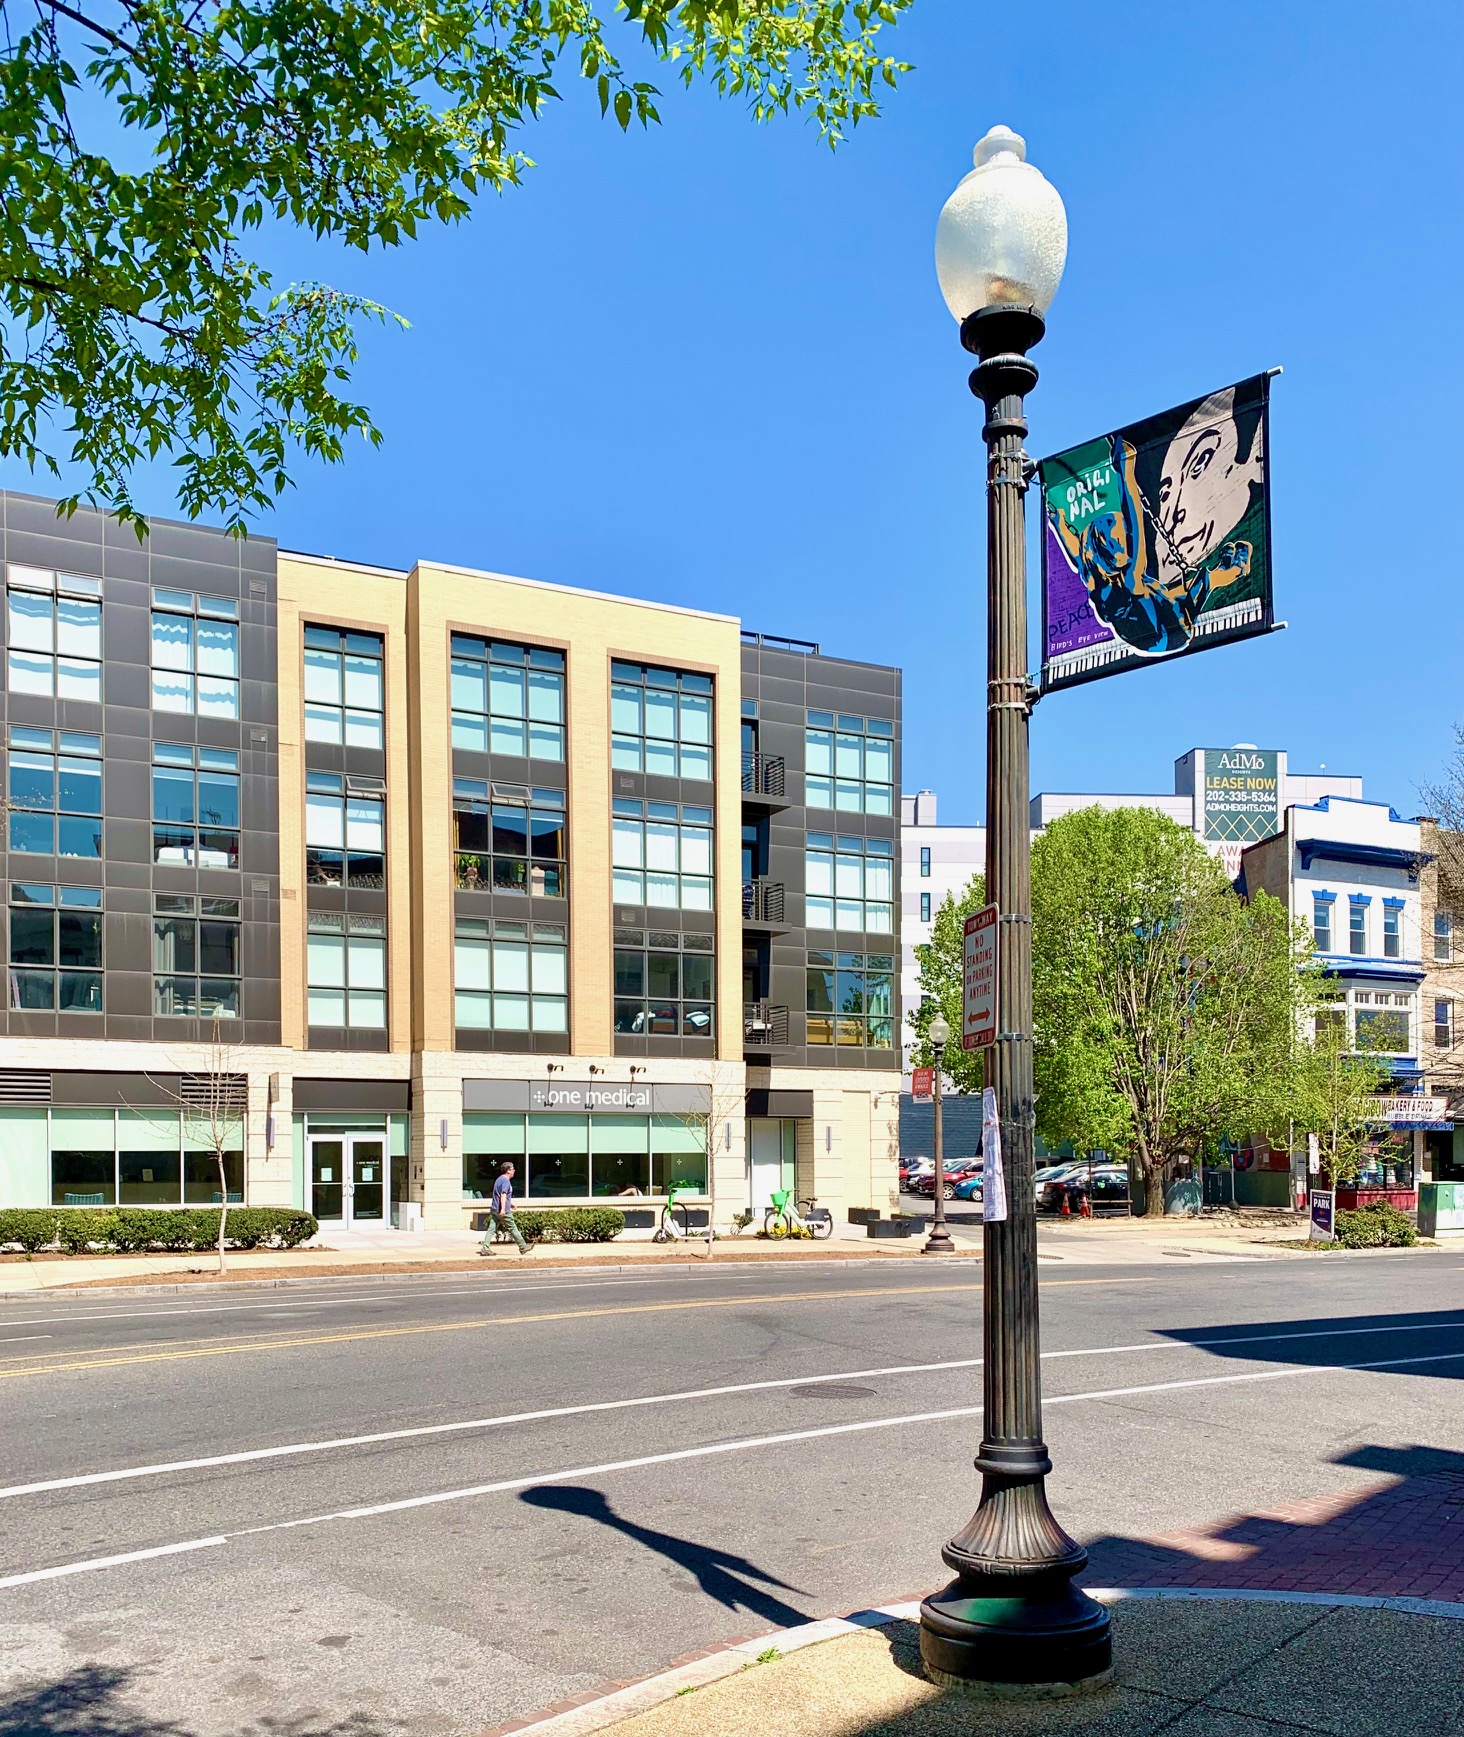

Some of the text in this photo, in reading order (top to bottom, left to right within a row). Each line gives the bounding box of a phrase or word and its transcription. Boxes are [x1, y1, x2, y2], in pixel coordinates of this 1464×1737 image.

[1070, 489, 1106, 523] NAL
[1050, 640, 1073, 652] BIRD'S
[1077, 635, 1091, 644] EYE
[1206, 776, 1276, 790] LEASE NOW
[1205, 790, 1276, 803] 202-335-5364
[1205, 803, 1276, 813] ADMOHEIGHTS.COM
[974, 934, 984, 949] NO
[966, 946, 992, 969] STANDING
[973, 963, 993, 983] PARKING
[969, 981, 991, 1001] ANYTIME
[548, 1088, 650, 1106] one medical
[1387, 1100, 1412, 1111] BAKERY
[1417, 1101, 1433, 1112] FOOD
[1313, 1198, 1330, 1210] PARK
